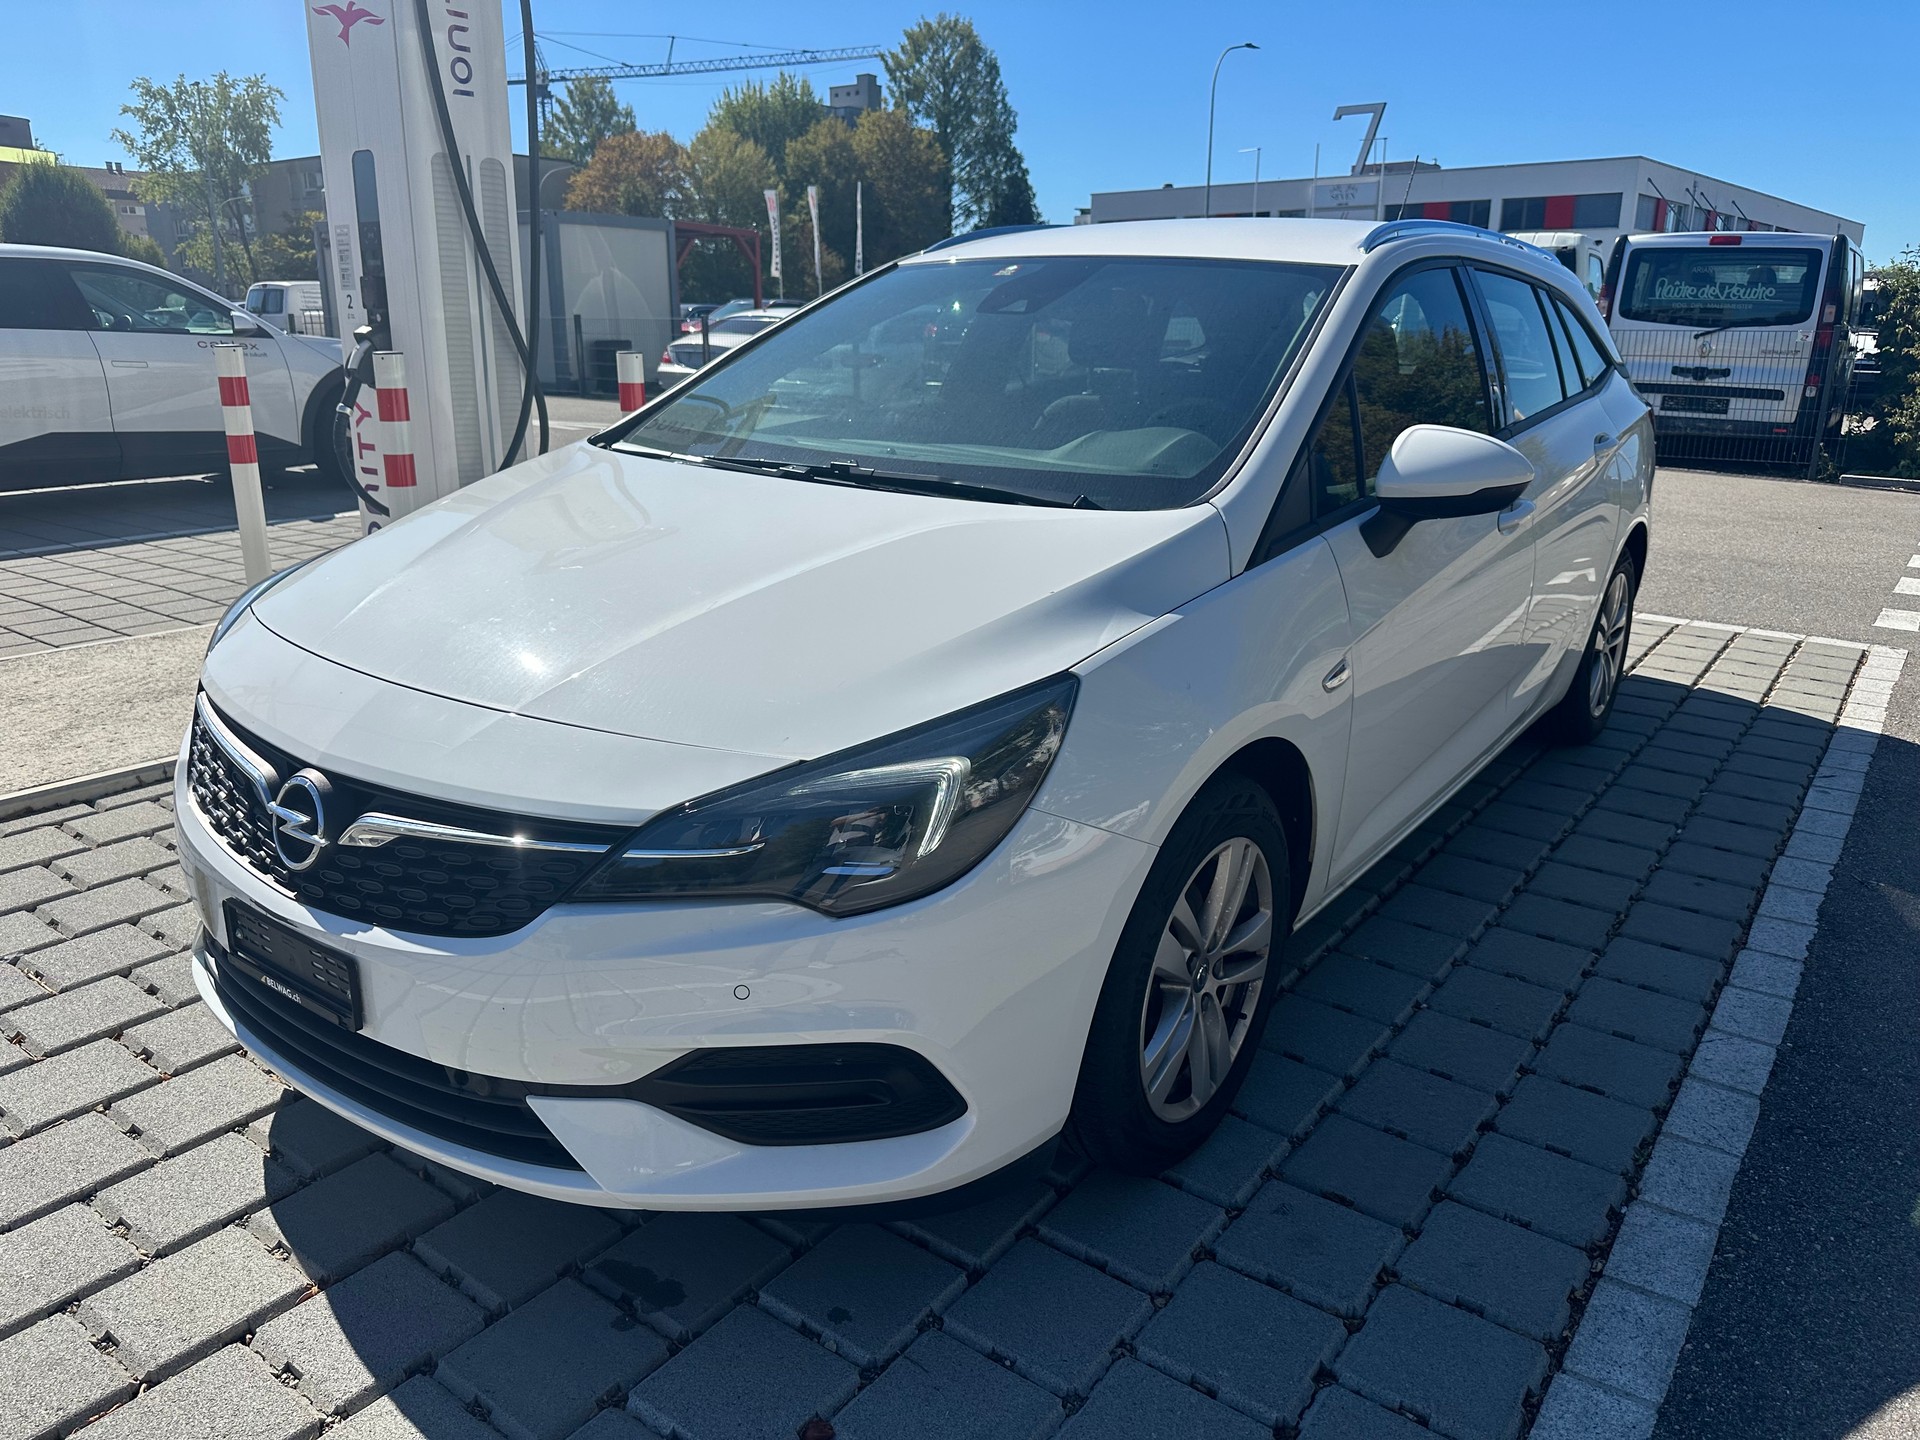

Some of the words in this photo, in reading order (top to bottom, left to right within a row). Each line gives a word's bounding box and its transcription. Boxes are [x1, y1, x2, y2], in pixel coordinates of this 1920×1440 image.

[445, 0, 475, 97] IONI
[346, 294, 354, 309] 2
[266, 976, 302, 1004] BELWAG.ch
